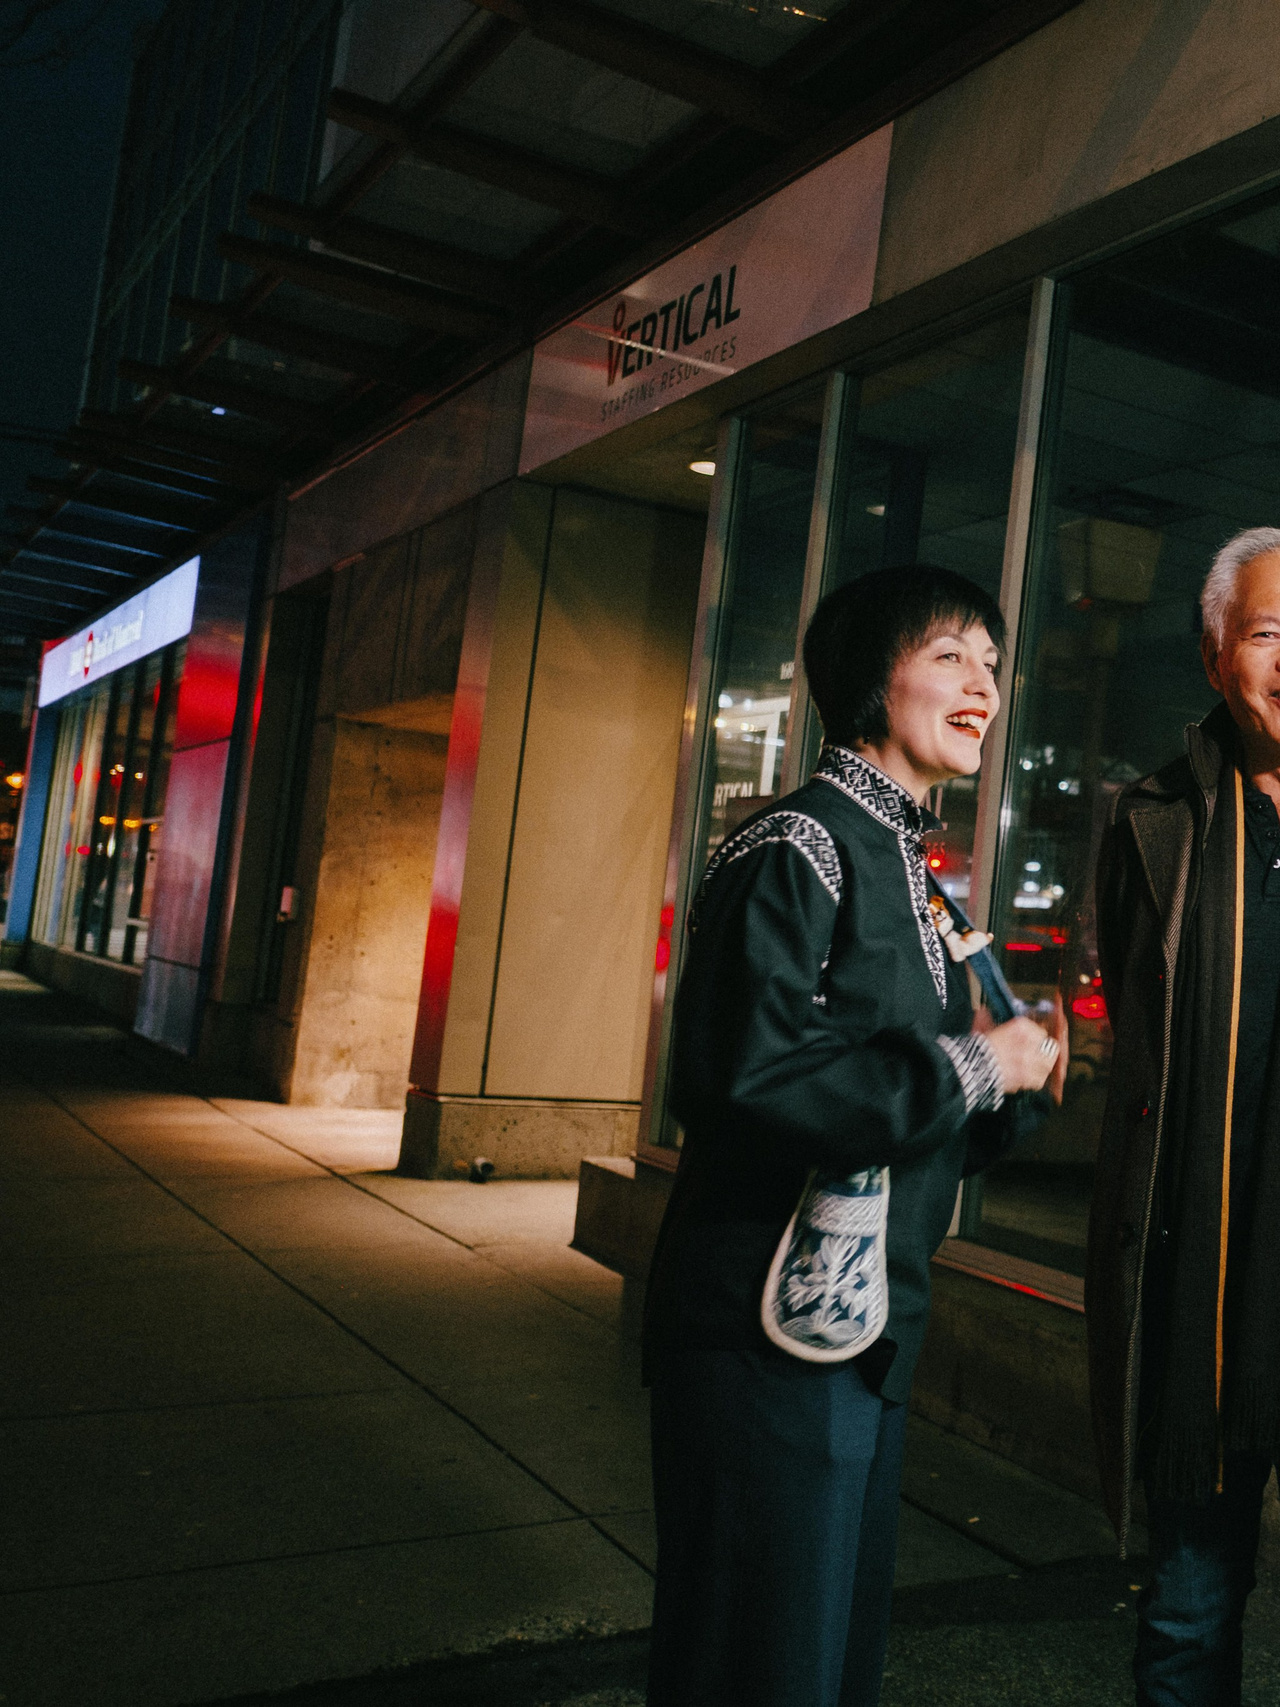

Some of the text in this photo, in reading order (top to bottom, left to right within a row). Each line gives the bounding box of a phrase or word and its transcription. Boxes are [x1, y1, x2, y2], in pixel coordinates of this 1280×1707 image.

[606, 264, 741, 387] VERTICAL
[601, 335, 738, 422] STAFFING RESOURCES
